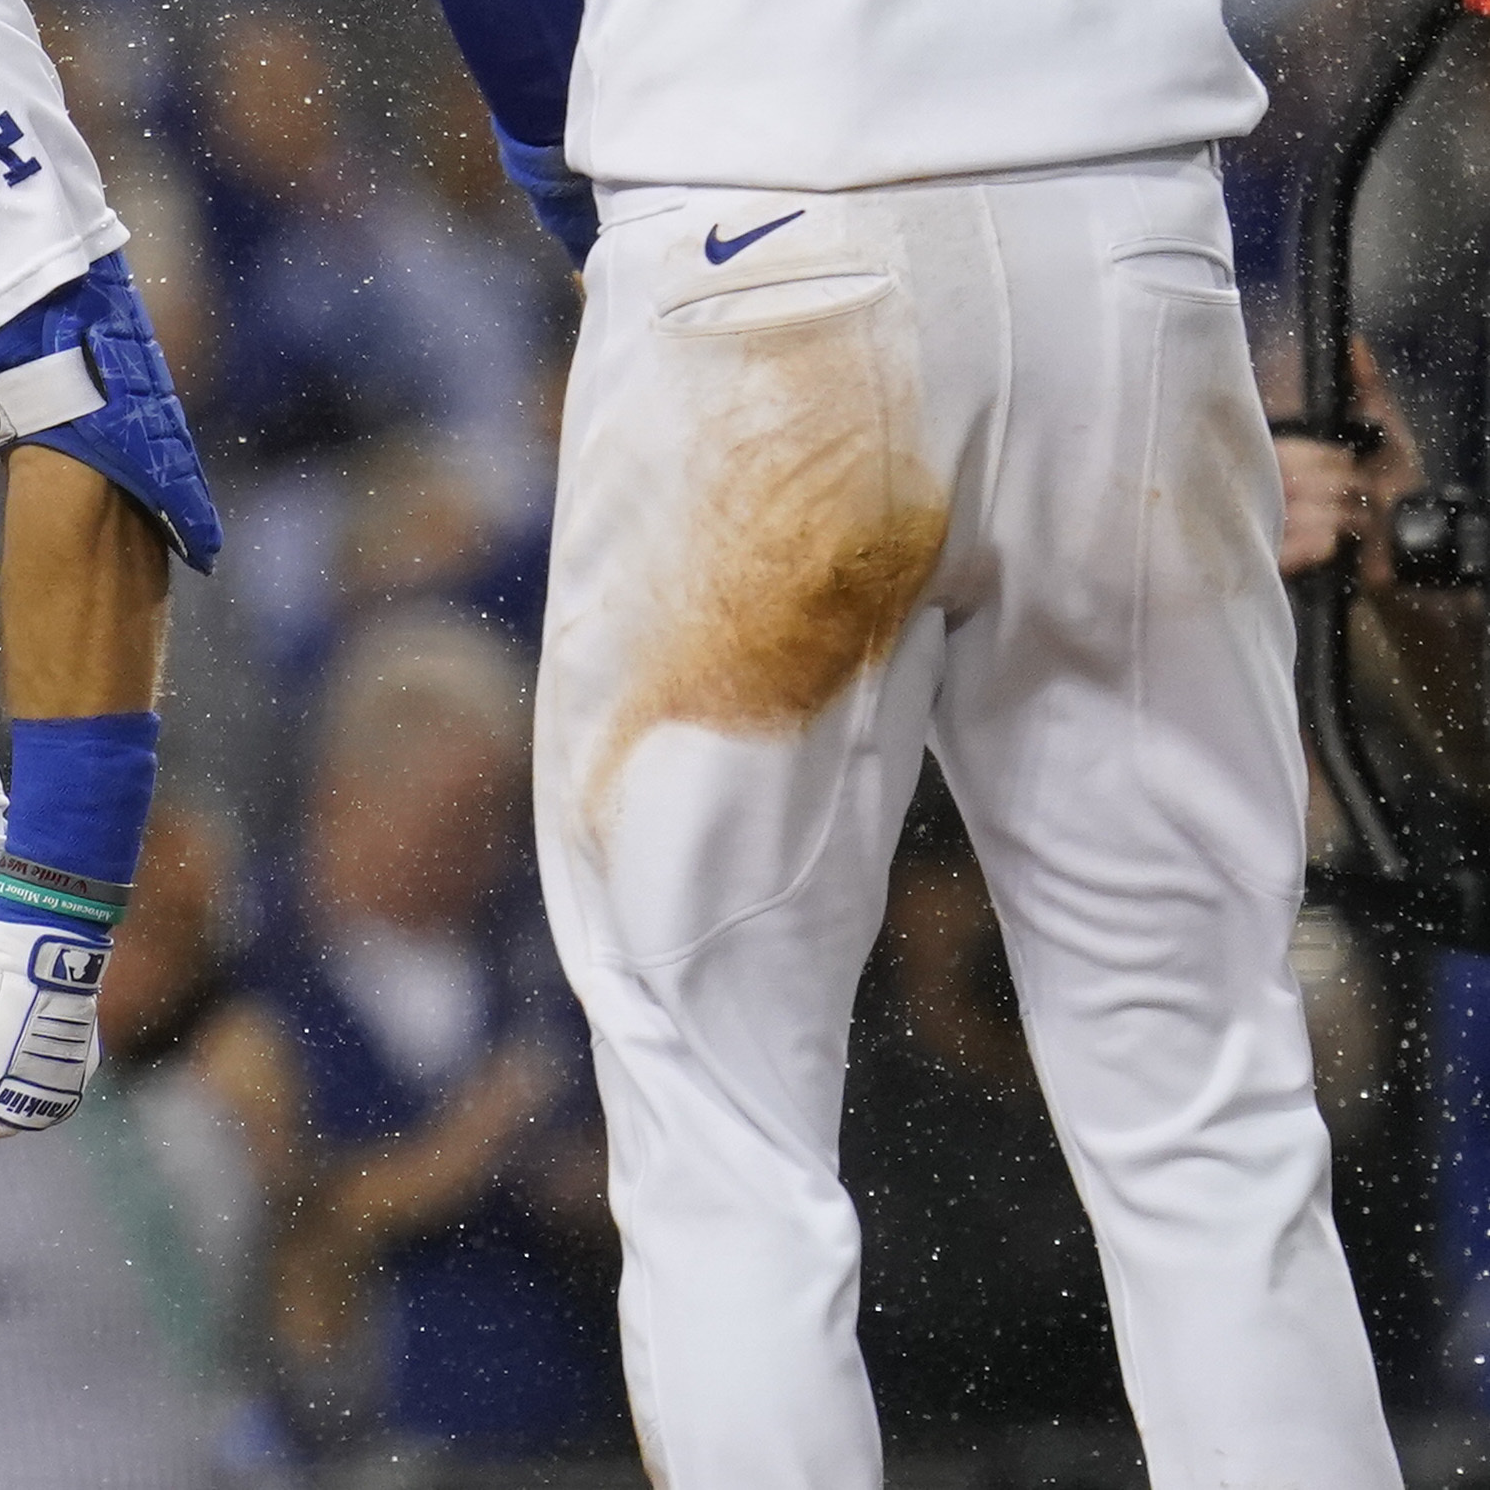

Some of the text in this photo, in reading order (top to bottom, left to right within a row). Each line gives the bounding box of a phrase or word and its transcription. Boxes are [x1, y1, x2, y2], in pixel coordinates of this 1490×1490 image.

[5, 883, 40, 903] Minor
[42, 894, 59, 909] for
[61, 900, 113, 920] Advocates
